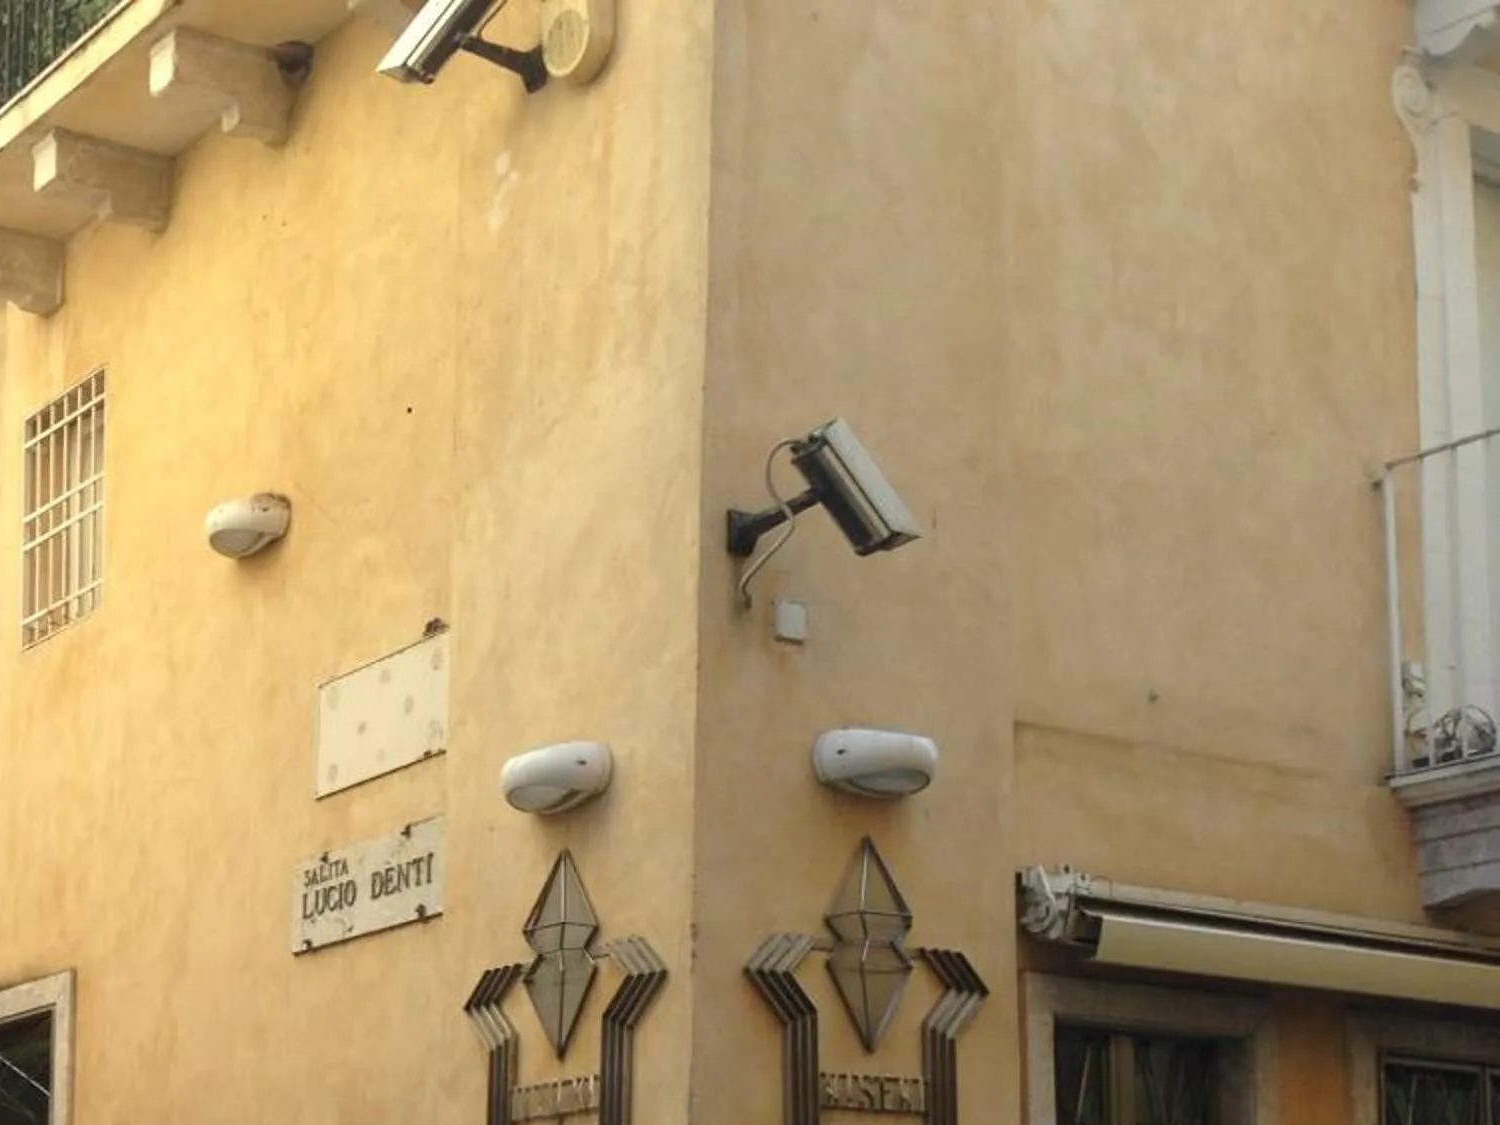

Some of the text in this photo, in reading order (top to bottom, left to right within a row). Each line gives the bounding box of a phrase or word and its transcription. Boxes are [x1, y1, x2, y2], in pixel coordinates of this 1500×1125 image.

[302, 852, 434, 919] LUCIO DENTI
[304, 858, 349, 887] SALITA
